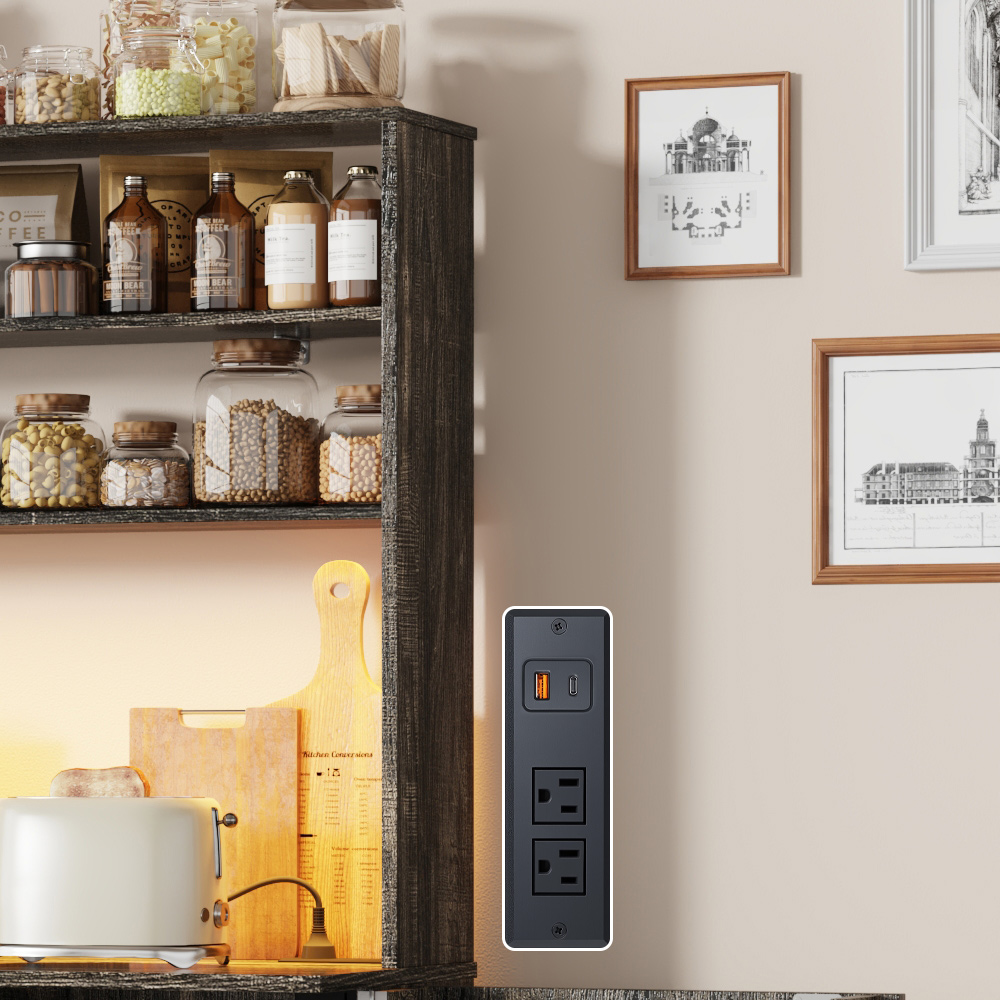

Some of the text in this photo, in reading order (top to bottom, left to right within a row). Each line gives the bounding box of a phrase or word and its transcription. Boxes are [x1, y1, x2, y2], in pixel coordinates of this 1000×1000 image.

[123, 281, 145, 290] BEAR
[211, 278, 233, 287] BEAR
[302, 750, 373, 758] Kitchen Conversions
